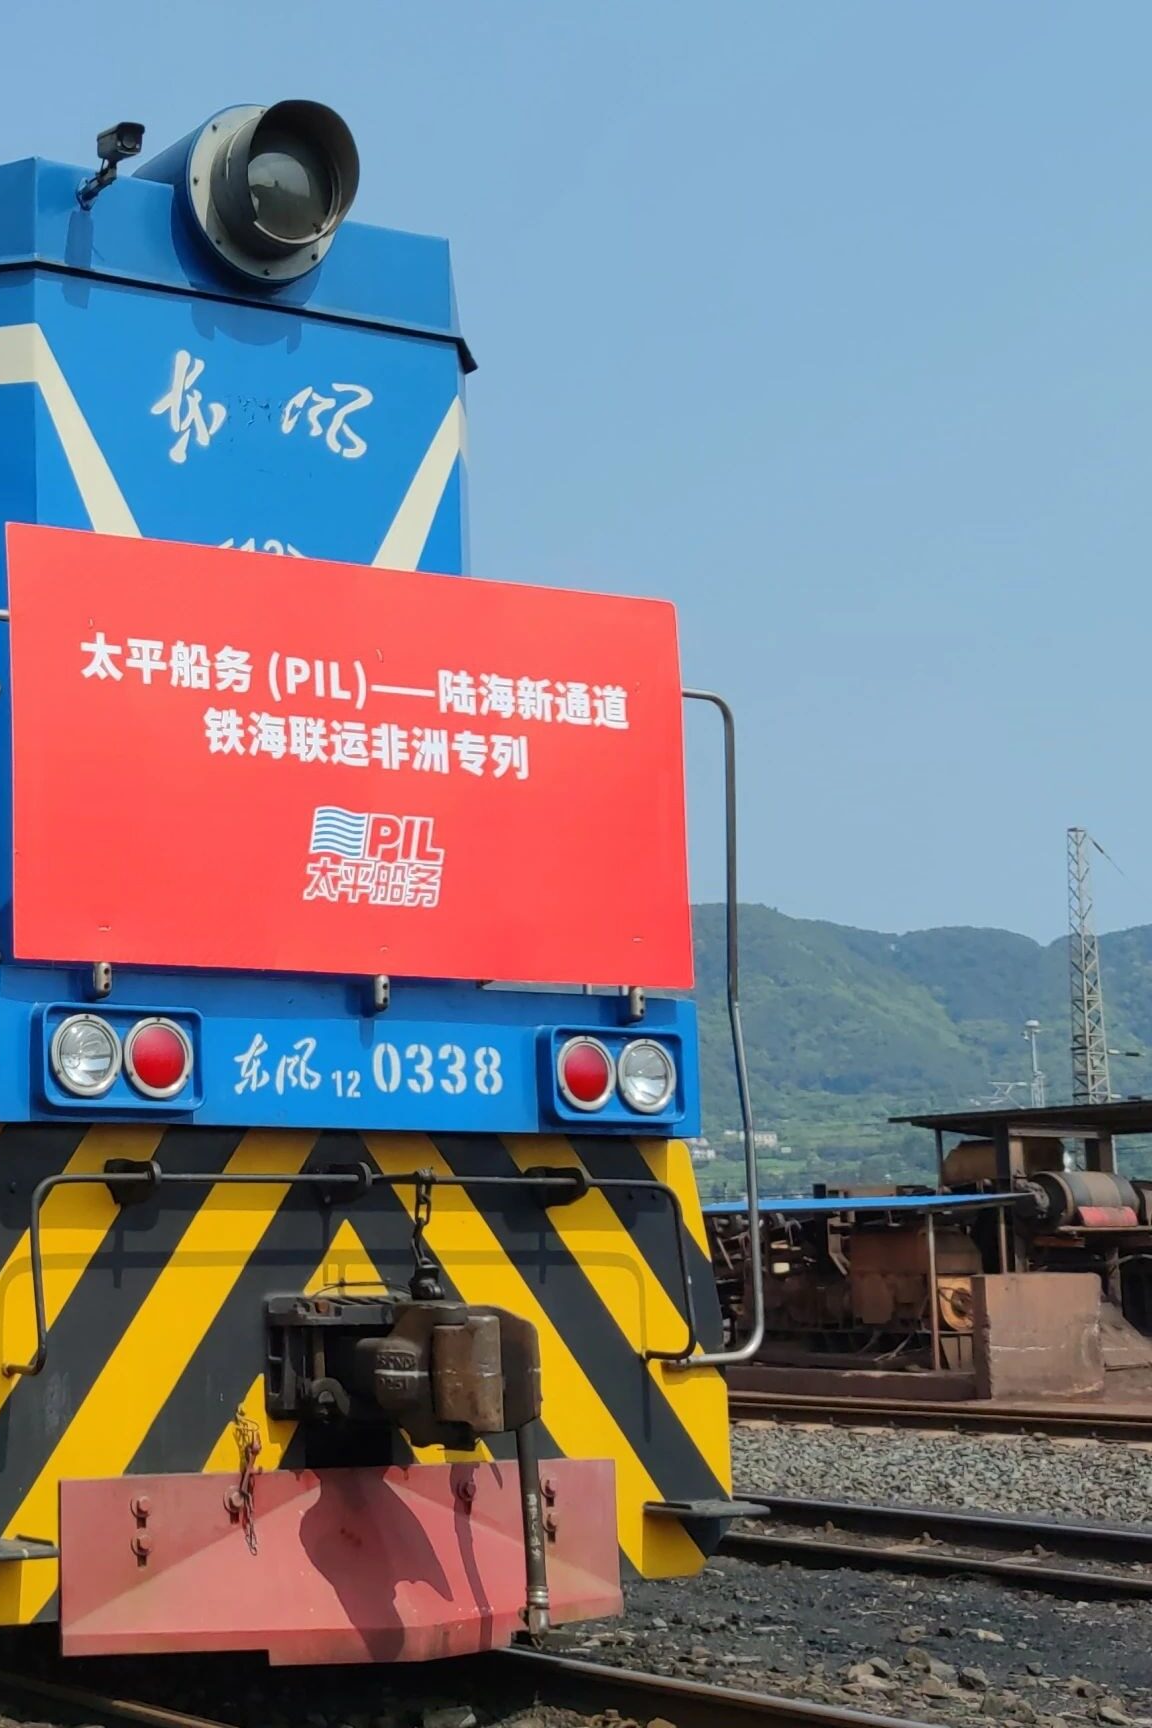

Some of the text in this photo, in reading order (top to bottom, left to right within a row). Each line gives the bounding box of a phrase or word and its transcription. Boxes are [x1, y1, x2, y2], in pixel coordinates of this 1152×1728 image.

[204, 706, 529, 781] 铁海联运非洲专列
[365, 813, 445, 864] PIL
[303, 857, 442, 907] 太平船务
[331, 1070, 362, 1099] 12
[373, 1043, 503, 1095] 0338
